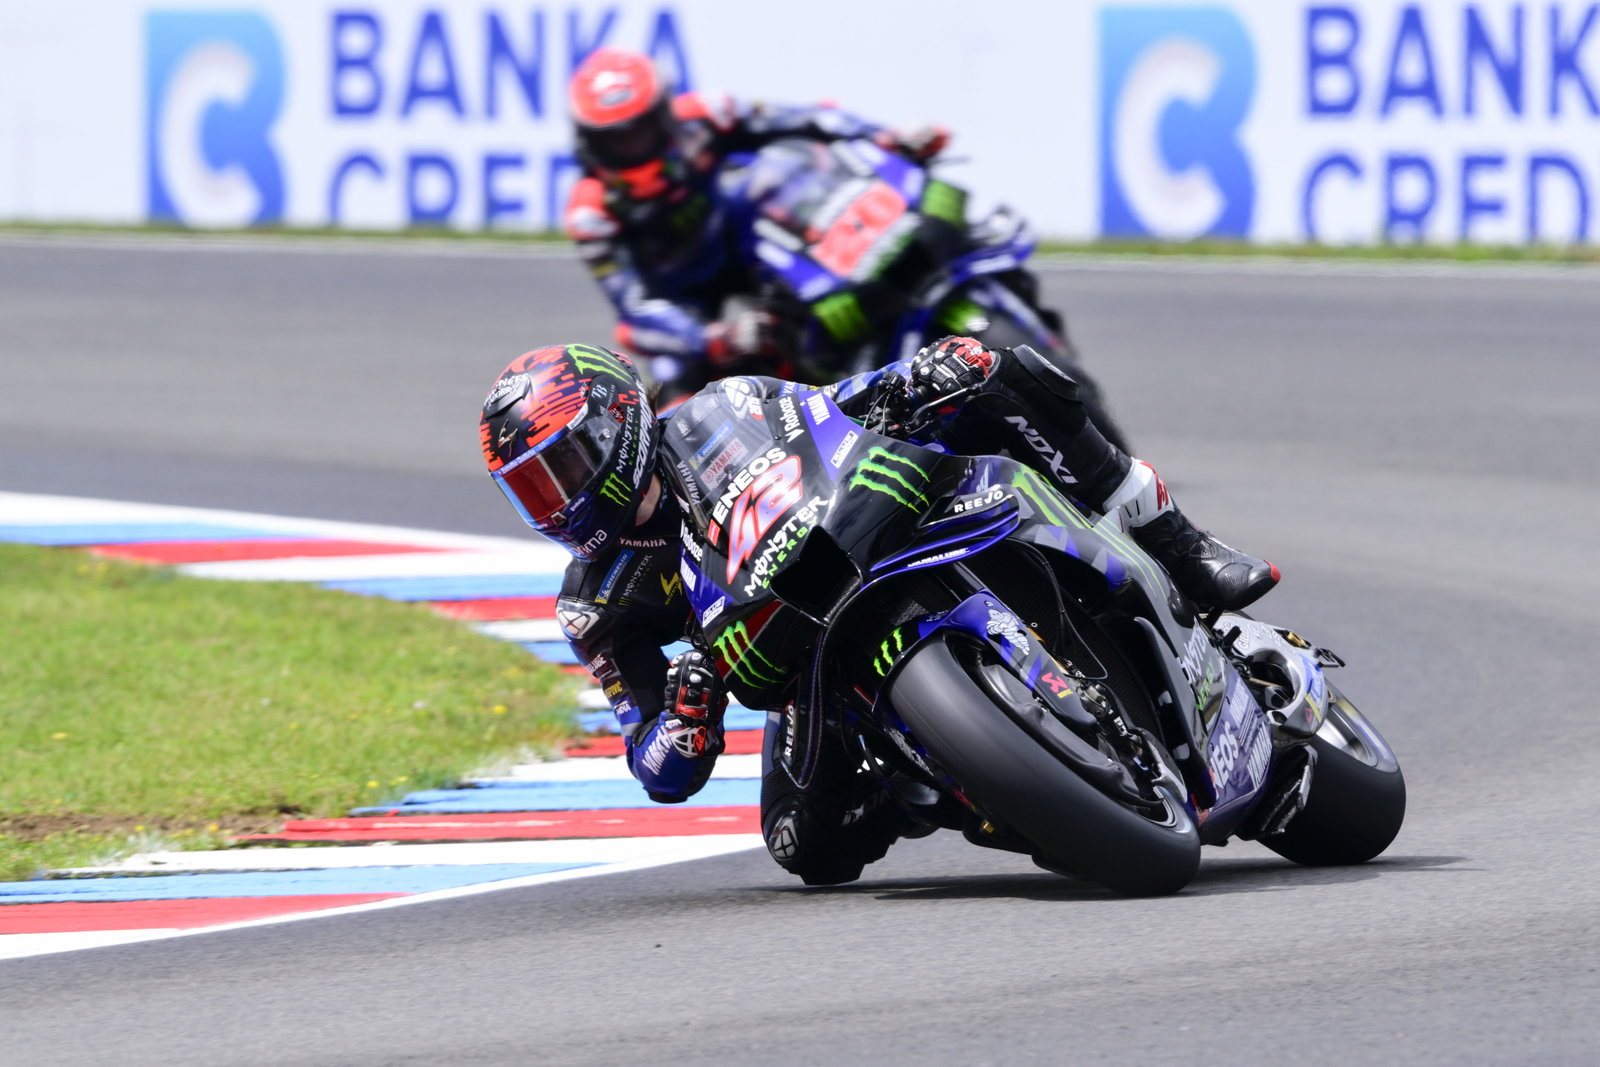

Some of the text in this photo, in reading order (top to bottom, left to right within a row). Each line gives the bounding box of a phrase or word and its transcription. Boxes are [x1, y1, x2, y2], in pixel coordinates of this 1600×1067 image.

[1307, 5, 1600, 118] BANK
[616, 406, 635, 473] MONSTER
[710, 440, 744, 473] YAMAHA
[677, 460, 701, 506] YAMAHA
[713, 447, 786, 525] ENEOS
[954, 490, 1004, 513] REEJO
[619, 537, 668, 547] YAMAHA
[726, 455, 803, 584] 42
[744, 496, 829, 597] MONSTER
[761, 516, 818, 589] ENERGY
[622, 553, 653, 597] MONSTER
[784, 704, 795, 757] REEJO
[1210, 720, 1239, 790] NEOS
